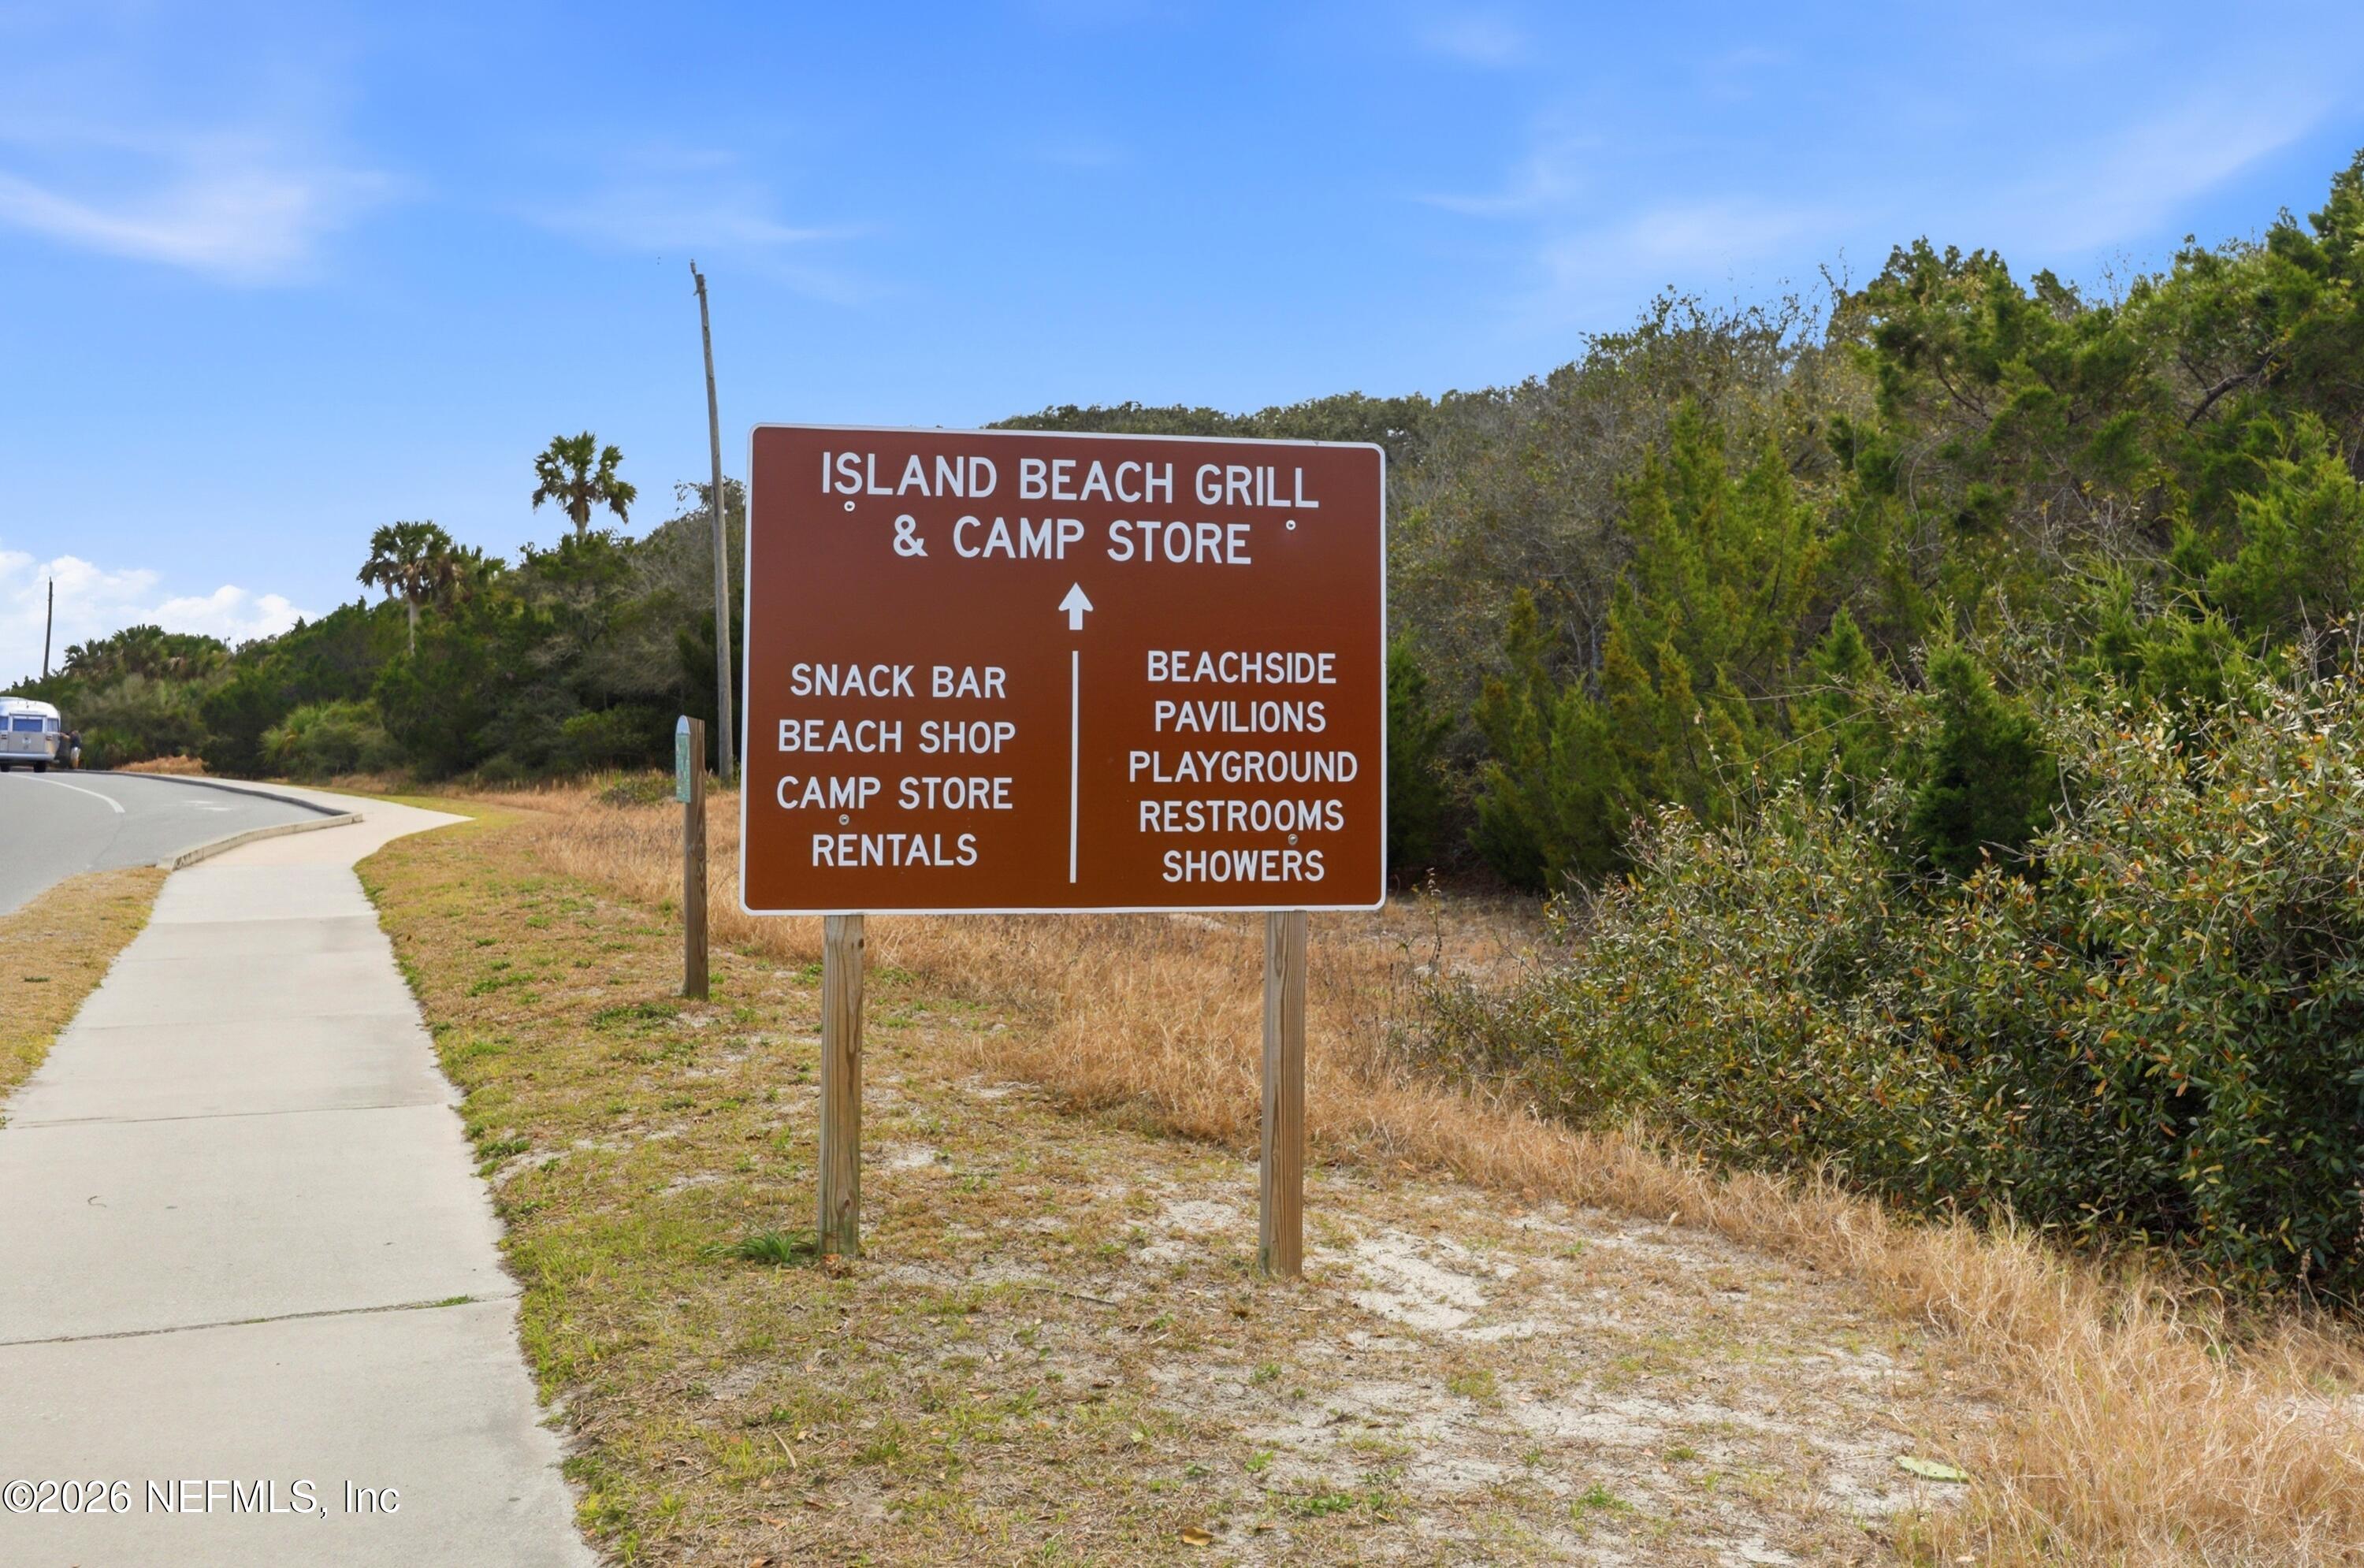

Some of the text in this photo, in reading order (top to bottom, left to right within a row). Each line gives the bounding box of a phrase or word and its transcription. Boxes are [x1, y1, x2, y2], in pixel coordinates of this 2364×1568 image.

[823, 451, 1318, 507] ISLAND BEACH GRILL
[894, 515, 1251, 564] & CAMP STORE
[790, 663, 1005, 698] SNACK BAR
[1148, 651, 1336, 683] BEACHSIDE
[1156, 701, 1325, 732] PAVILIONS
[779, 719, 1015, 753] BEACH SHOP
[1130, 751, 1357, 782] PLAYGROUND
[777, 776, 1013, 809] CAMP STORE
[1140, 800, 1344, 832] RESTROOMS
[813, 834, 977, 866] RENTALS
[1163, 850, 1324, 882] SHOWERS
